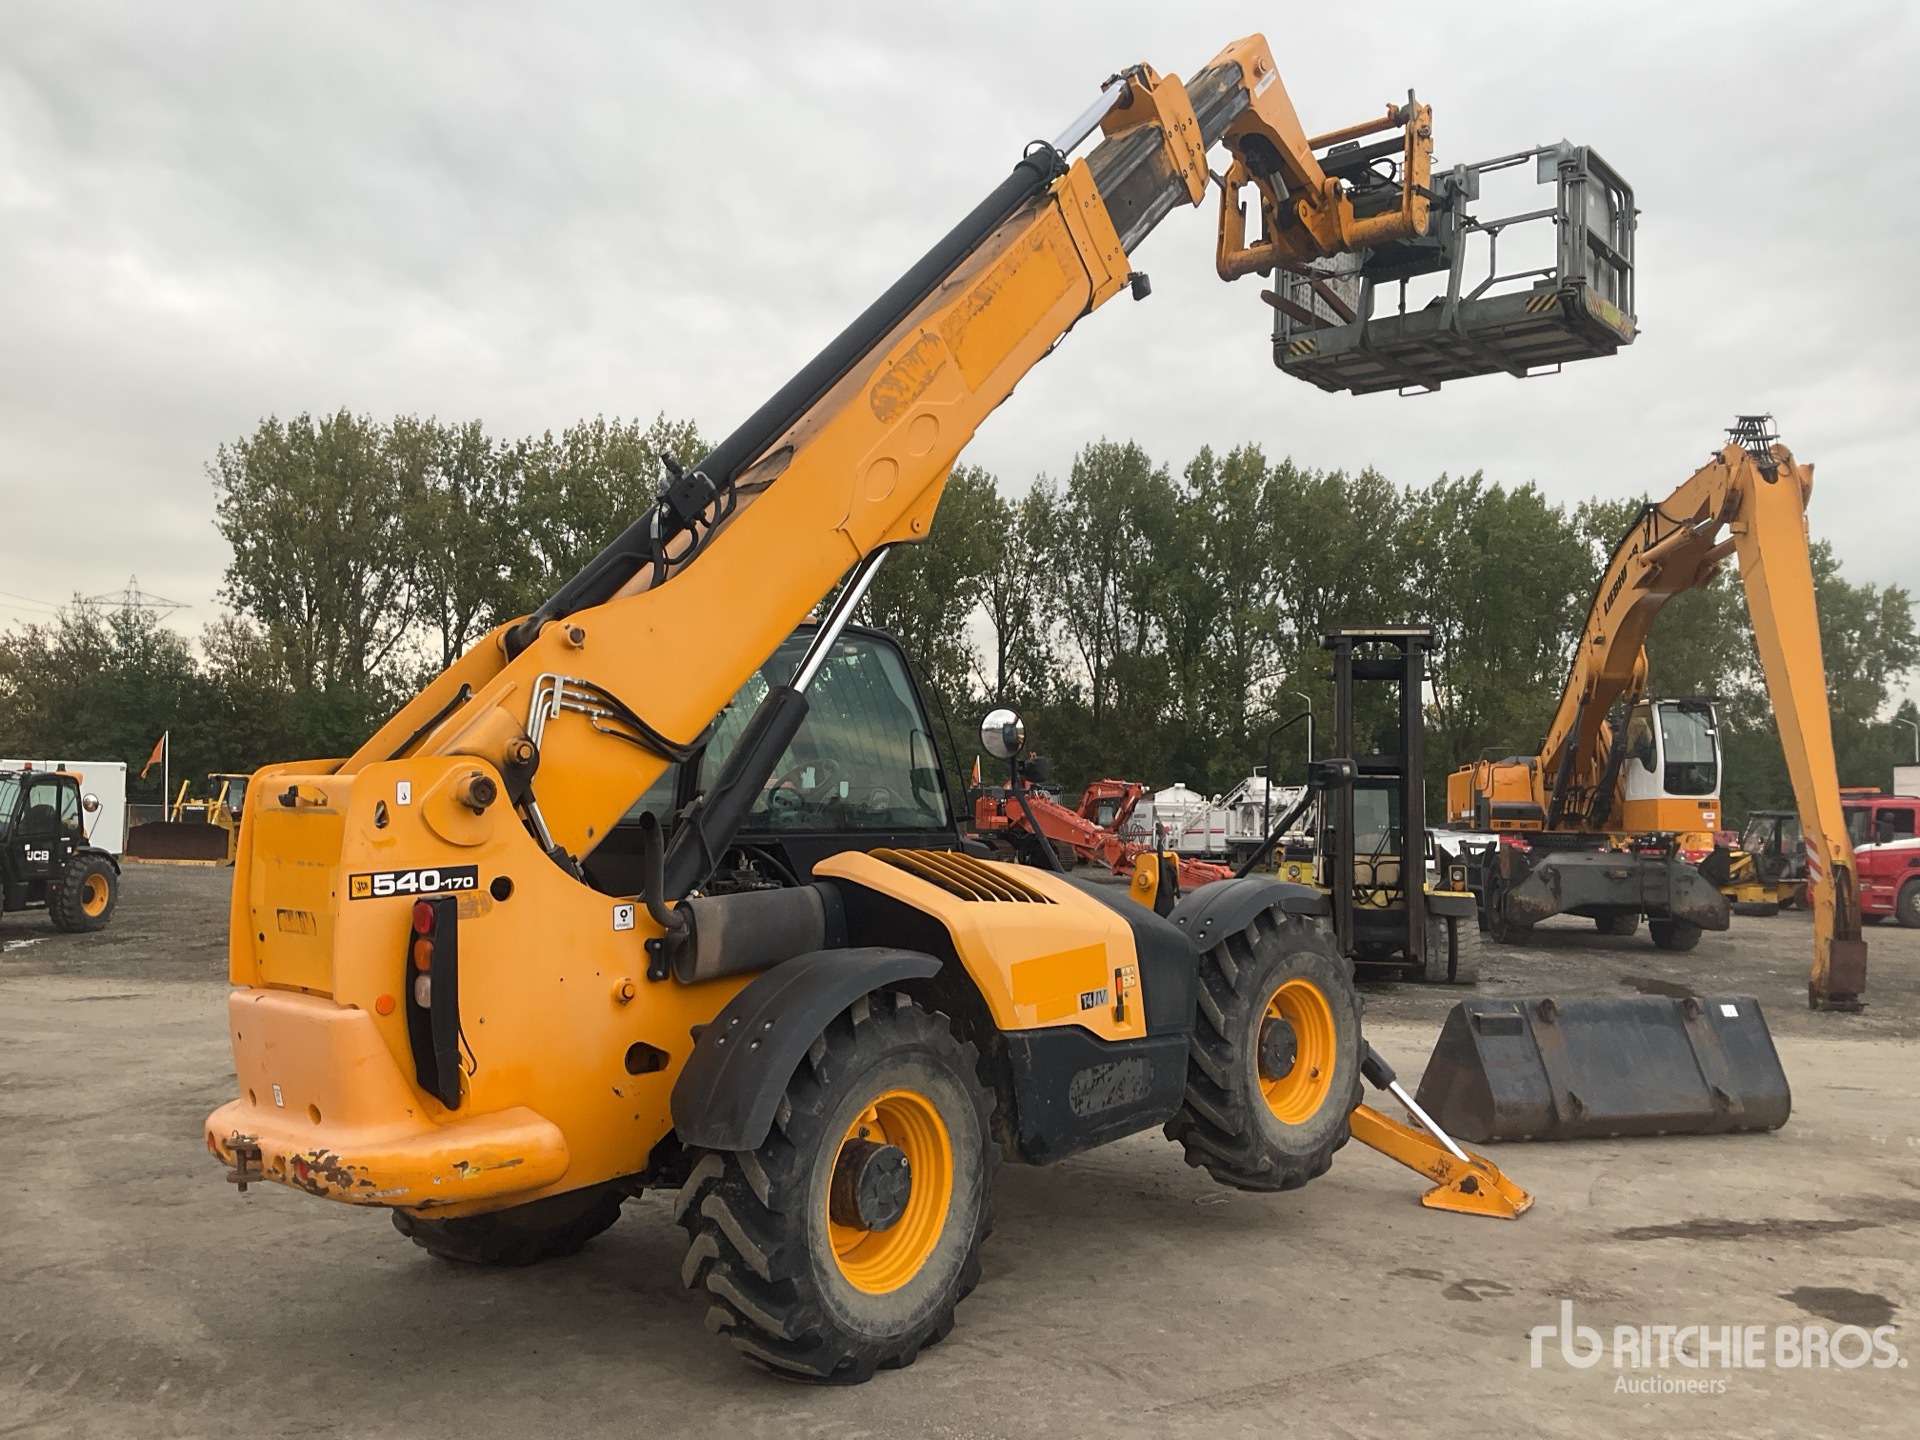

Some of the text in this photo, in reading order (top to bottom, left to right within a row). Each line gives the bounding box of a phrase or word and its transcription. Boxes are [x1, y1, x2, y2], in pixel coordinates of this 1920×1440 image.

[27, 851, 49, 861] JCB
[373, 870, 474, 896] 540-170
[1081, 993, 1093, 1009] T4
